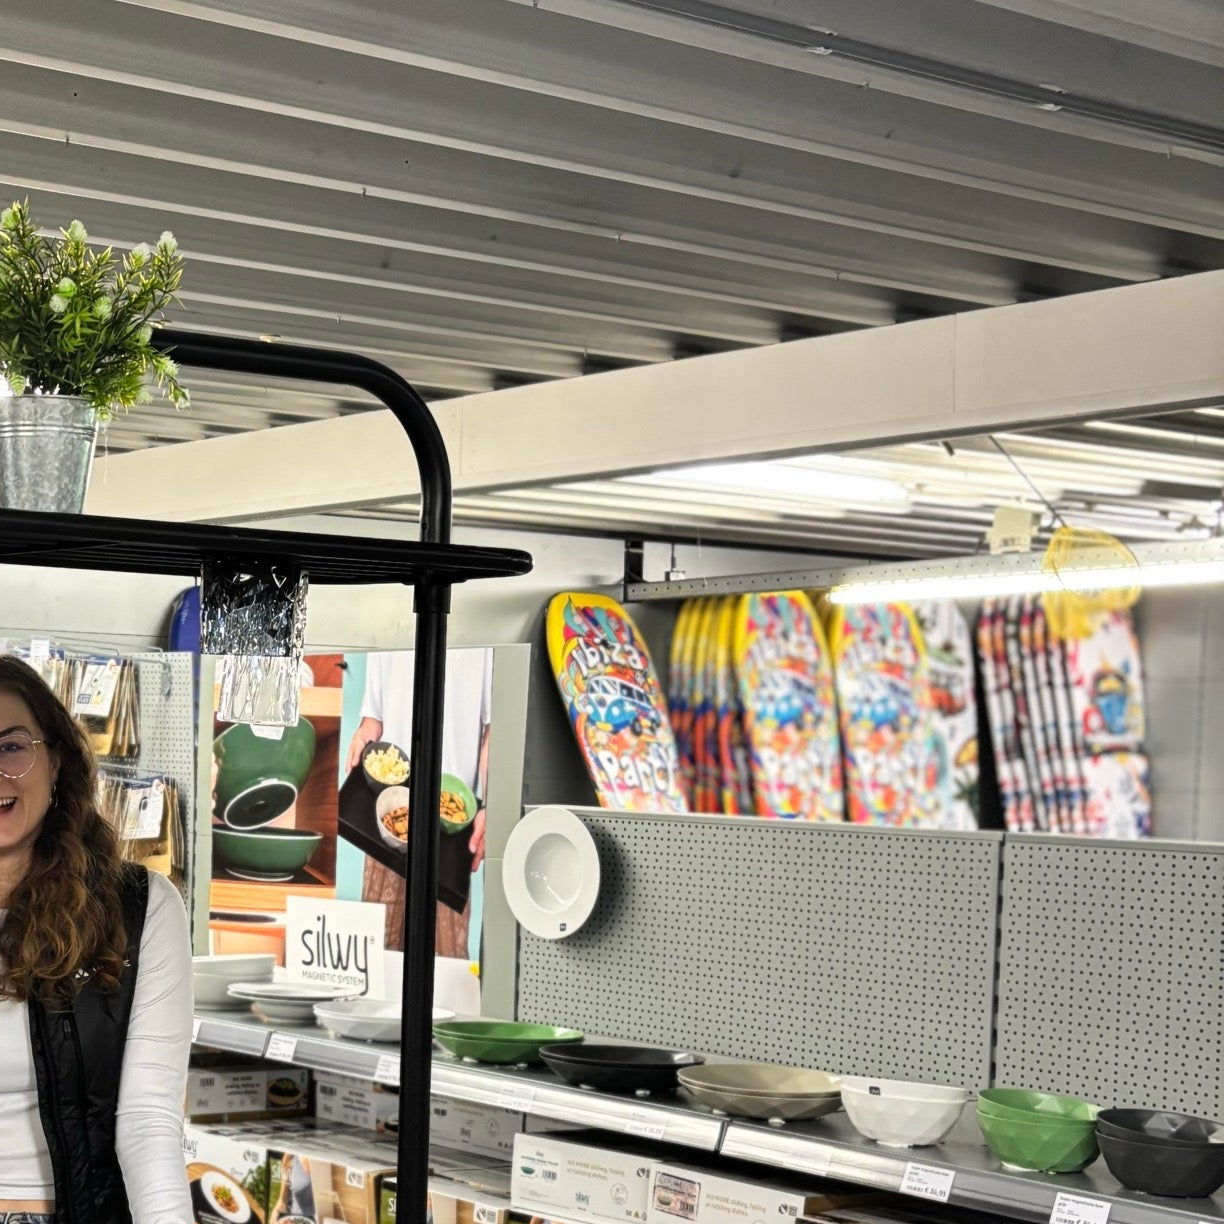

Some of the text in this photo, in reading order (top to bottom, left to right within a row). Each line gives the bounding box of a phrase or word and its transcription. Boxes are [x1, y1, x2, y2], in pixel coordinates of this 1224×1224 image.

[572, 637, 643, 678] Ibiza
[598, 749, 675, 800] Party
[302, 971, 364, 986] MAGNETIC SYSTEM
